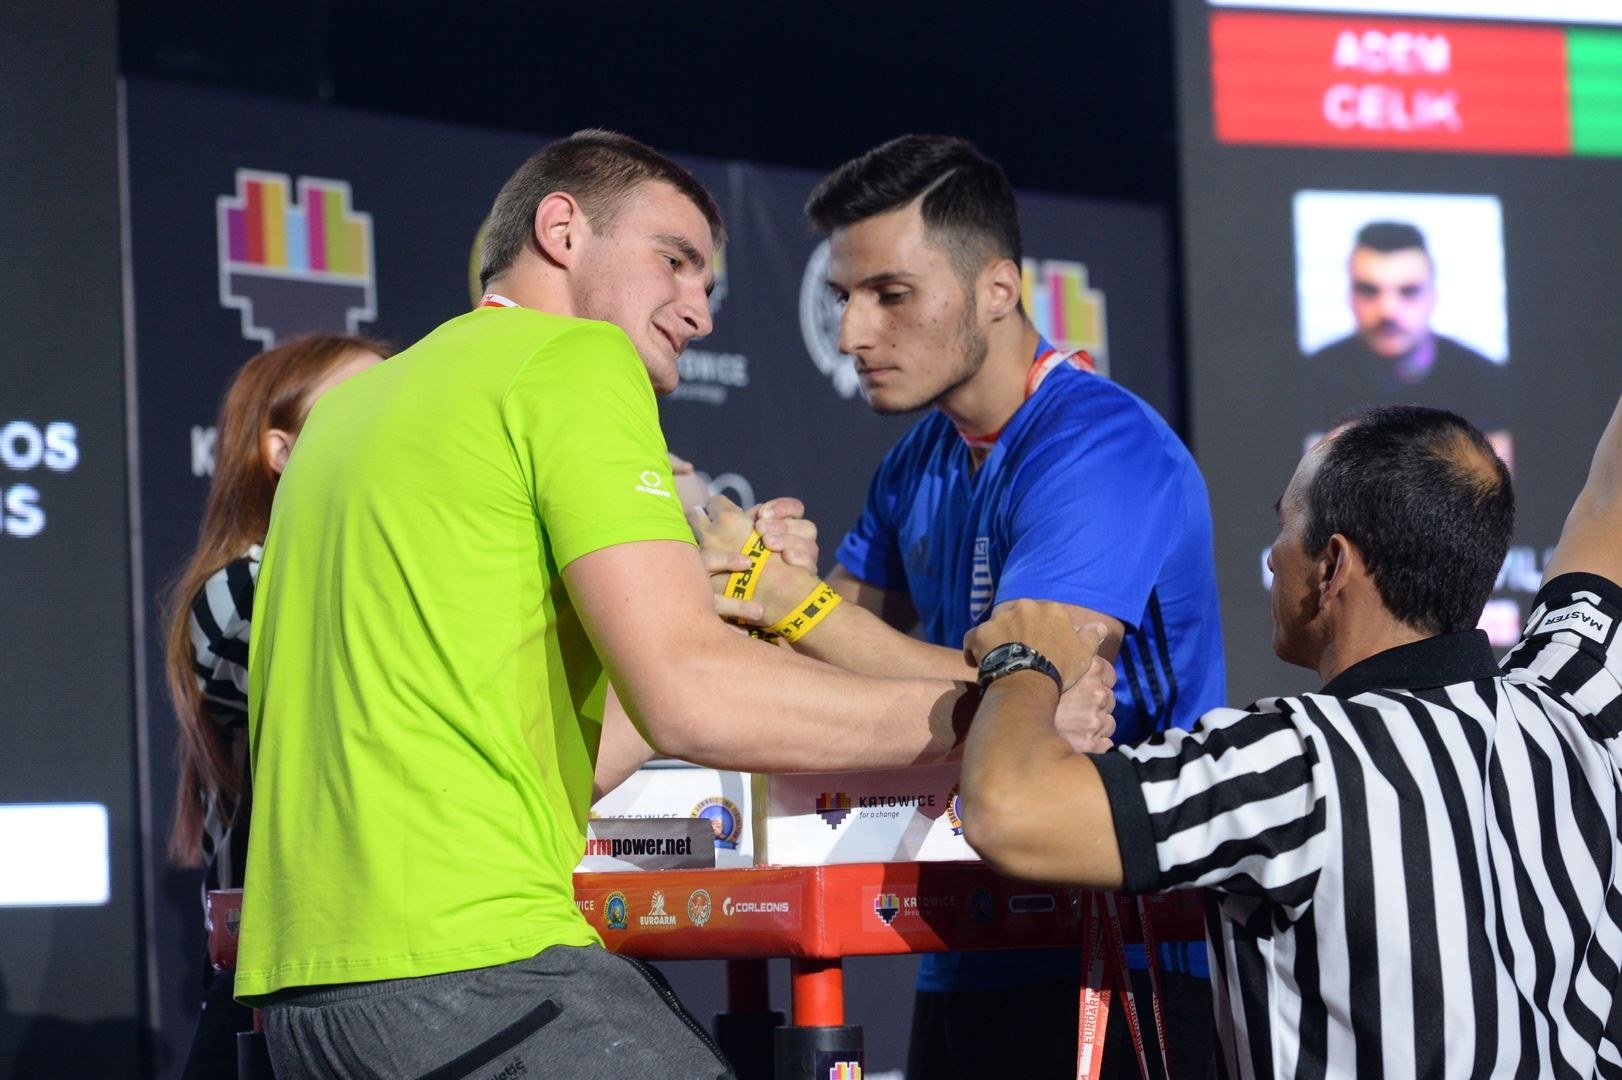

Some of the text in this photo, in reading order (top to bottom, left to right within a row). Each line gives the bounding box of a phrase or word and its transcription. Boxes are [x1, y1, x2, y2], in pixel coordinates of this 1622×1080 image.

[1544, 611, 1604, 632] MASTER
[859, 794, 935, 809] KATOWICE
[860, 811, 869, 819] for
[876, 811, 900, 819] change
[735, 902, 790, 913] CORLEONIS
[640, 916, 677, 926] EUROARM
[1085, 988, 1101, 1045] EUROARM
